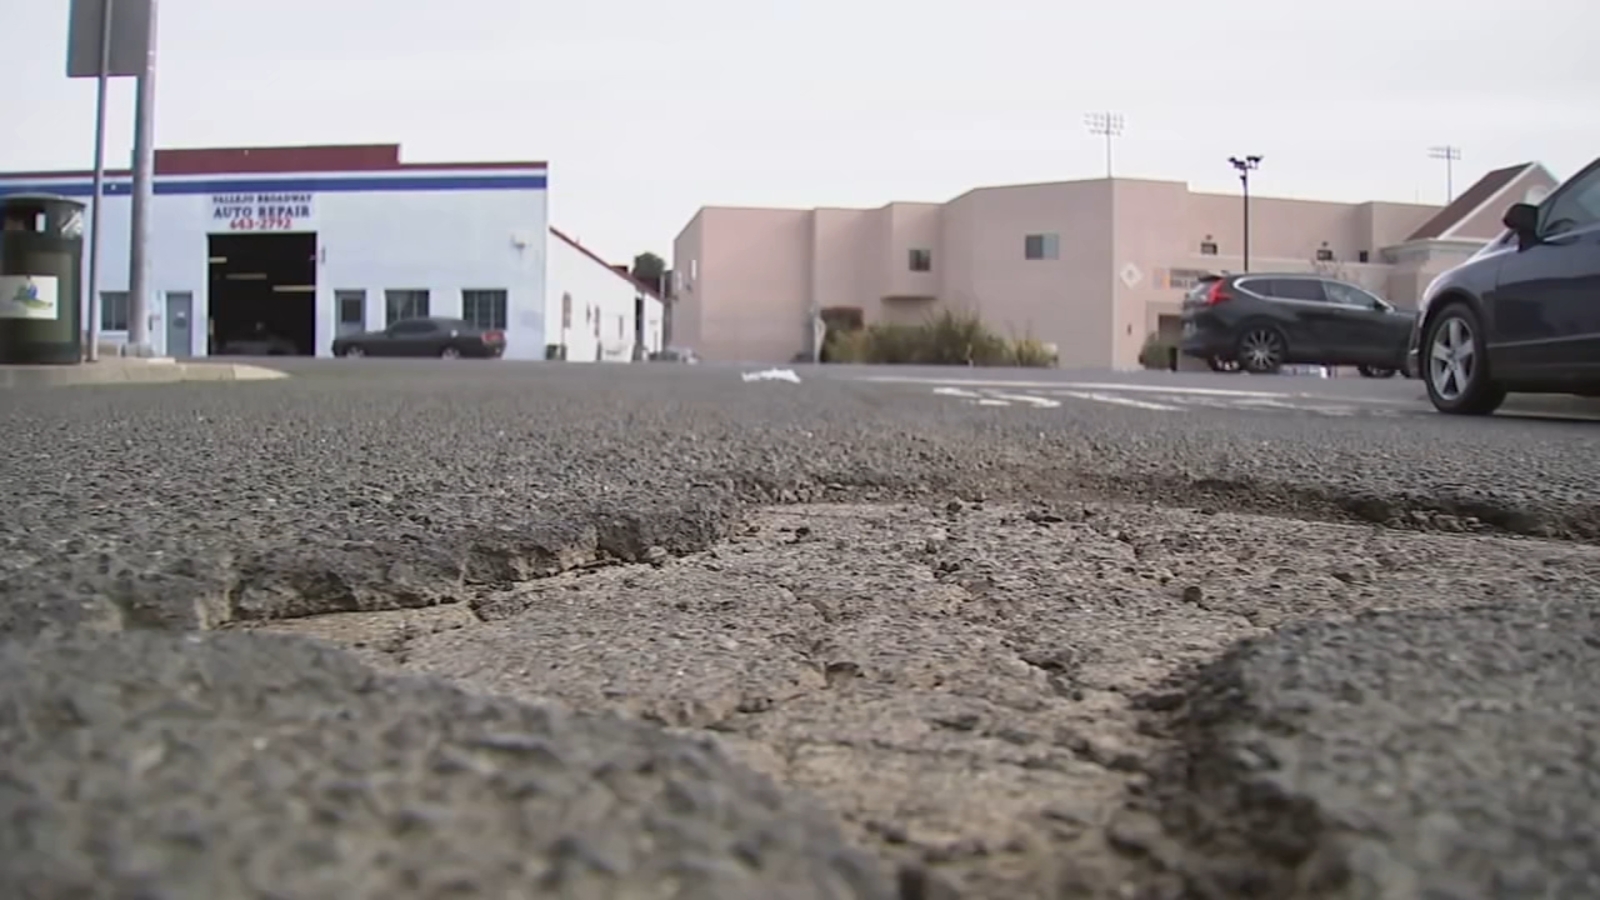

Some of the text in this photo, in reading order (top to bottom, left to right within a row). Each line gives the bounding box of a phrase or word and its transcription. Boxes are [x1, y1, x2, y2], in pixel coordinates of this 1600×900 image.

[258, 194, 312, 202] BROADWAY
[214, 205, 310, 218] AUTO REPAIR
